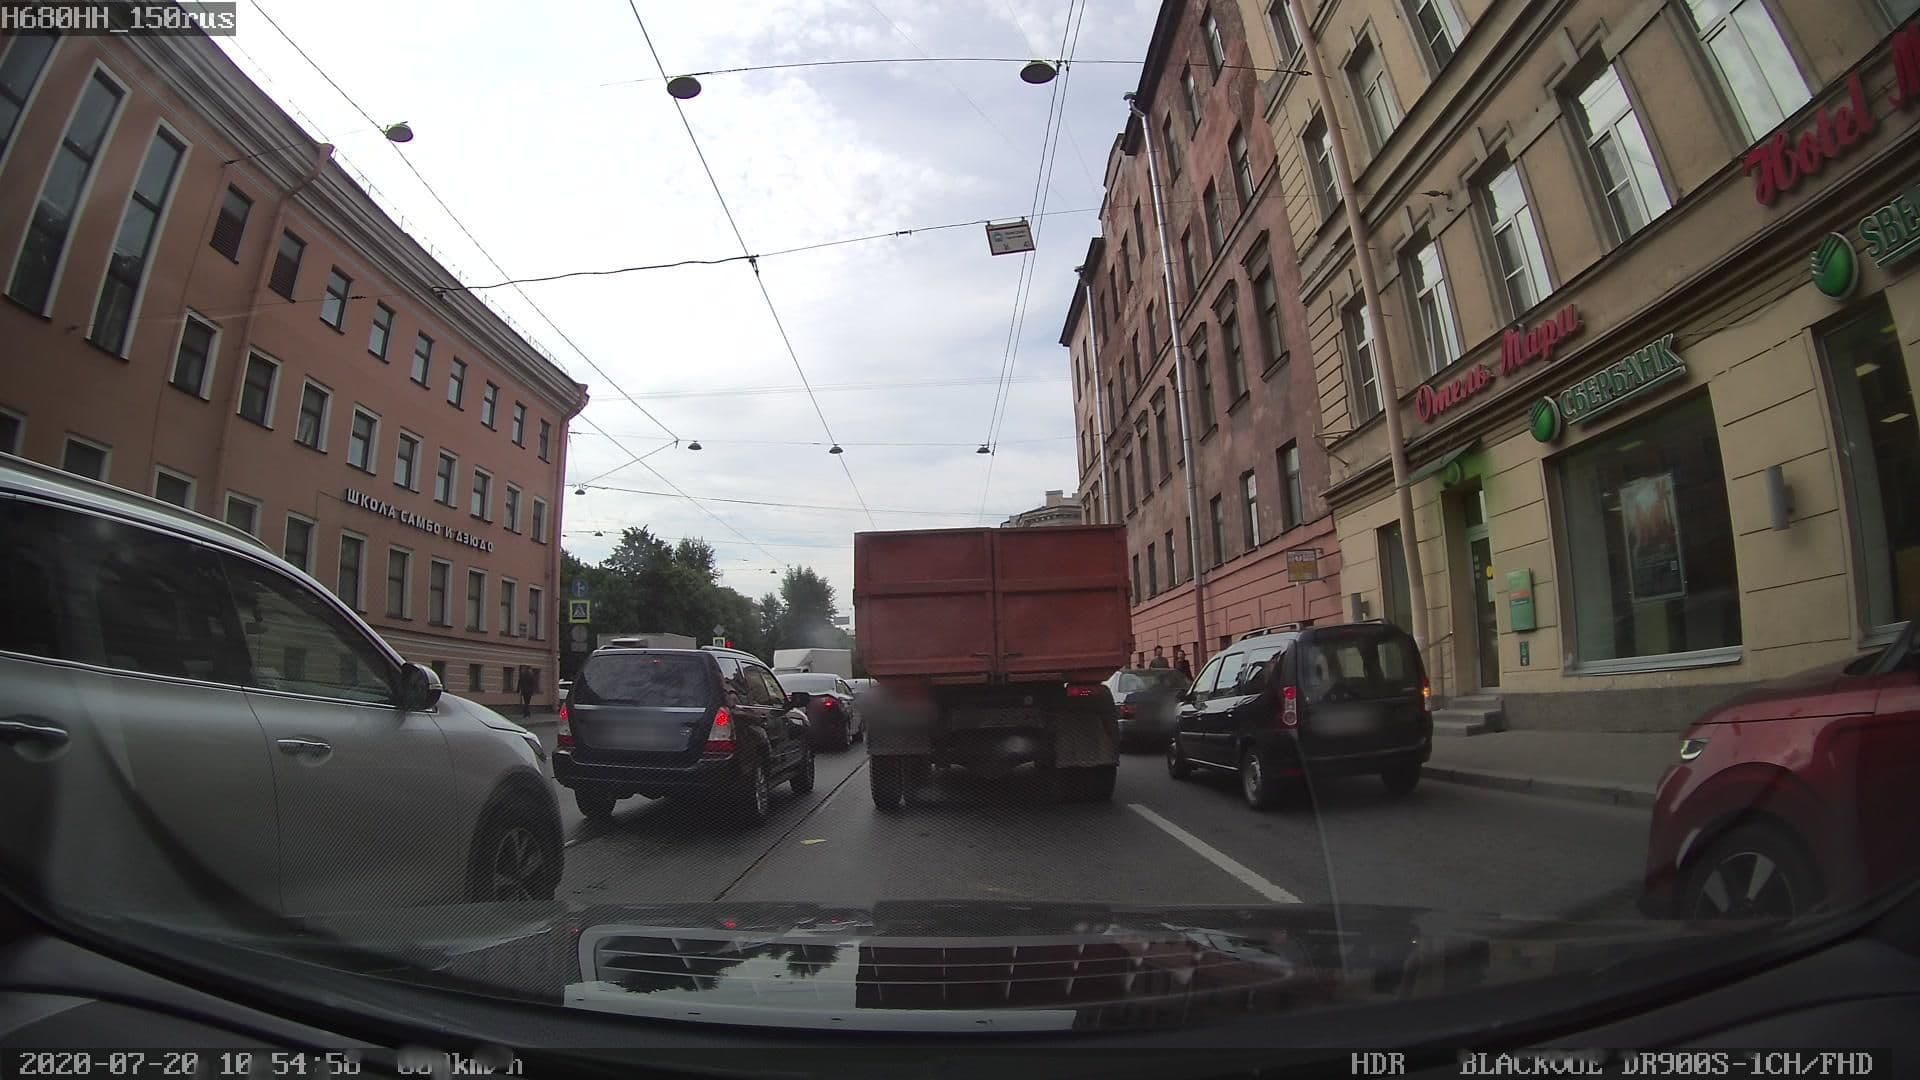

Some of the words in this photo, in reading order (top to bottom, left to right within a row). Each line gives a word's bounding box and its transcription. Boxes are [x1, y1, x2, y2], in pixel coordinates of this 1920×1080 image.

[1743, 72, 1874, 206] Hotel
[1416, 364, 1497, 423] Отель
[1498, 303, 1584, 378] Мари
[1559, 333, 1688, 417] СБЕРБАНК
[346, 488, 396, 519] ШКОЛА
[400, 509, 441, 534] САМБО
[445, 526, 453, 539] И
[455, 531, 495, 553] ДЗЮДО
